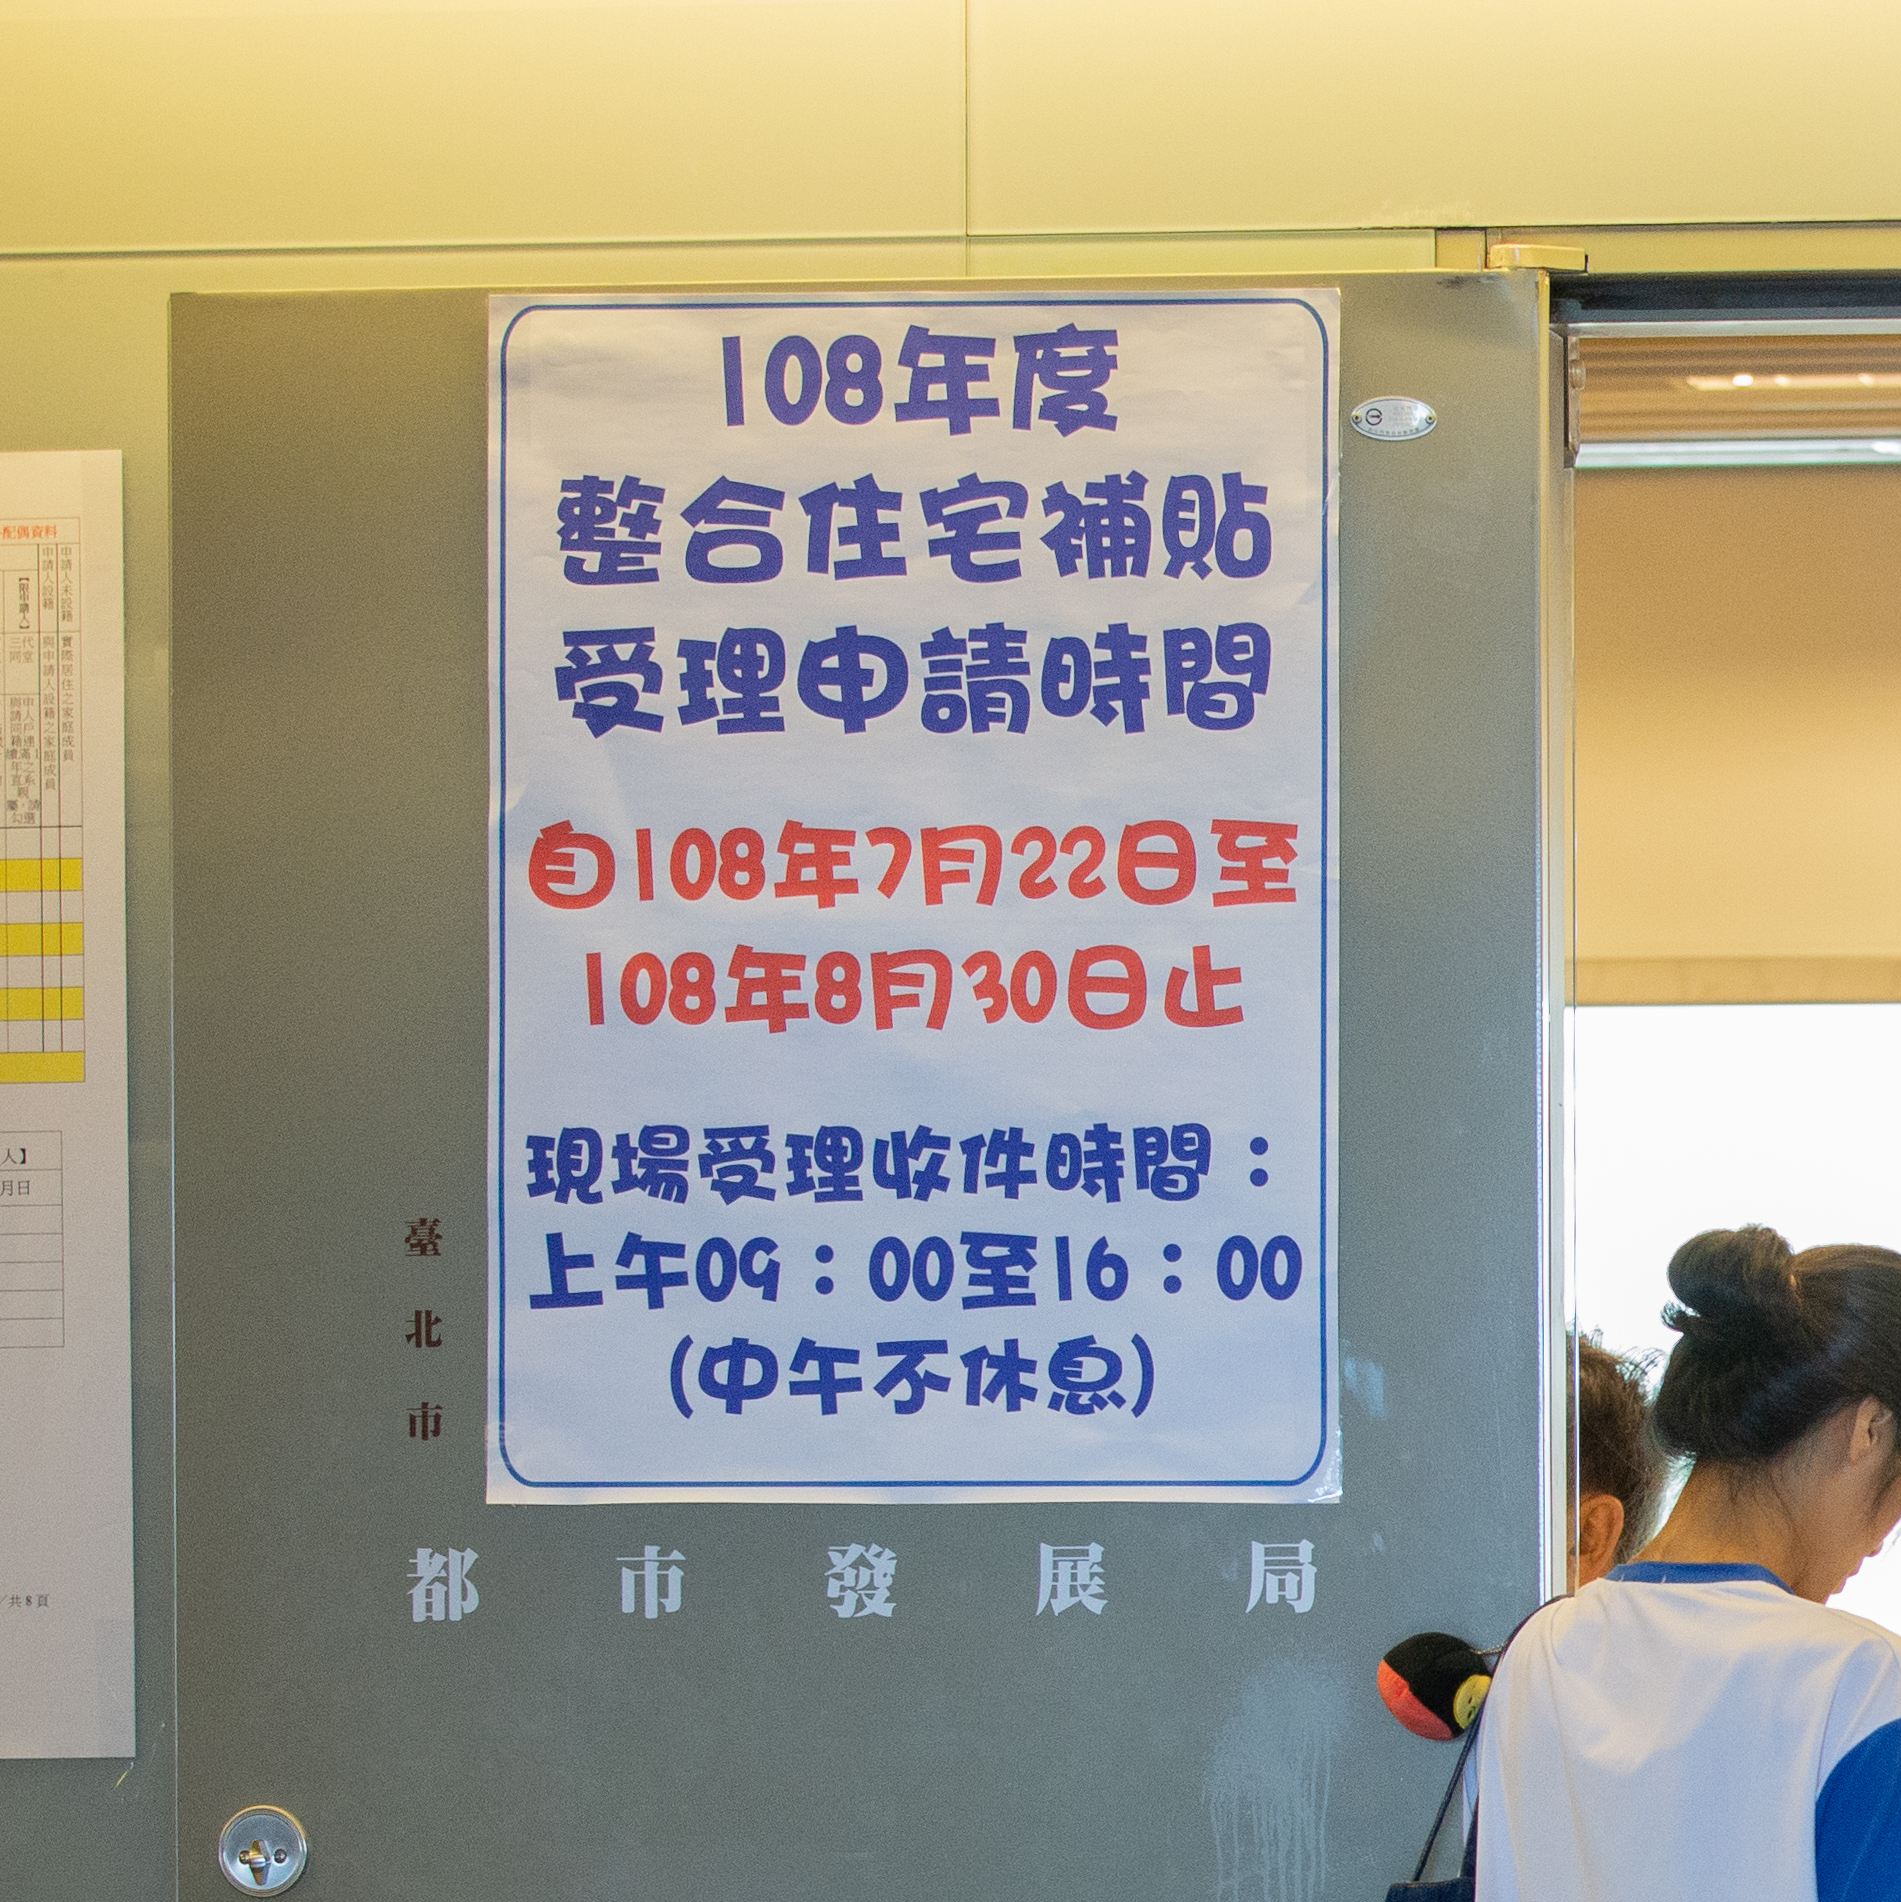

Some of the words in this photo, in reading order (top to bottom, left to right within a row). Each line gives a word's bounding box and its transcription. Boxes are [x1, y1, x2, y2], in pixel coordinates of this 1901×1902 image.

[722, 327, 1118, 433] 108年度
[557, 475, 1271, 584] 整合住宅補貼
[555, 624, 1271, 733] 受理申請時間
[528, 820, 1298, 906] 自108年7月22日至
[586, 946, 1243, 1029] 108年8月30日止
[0, 1180, 30, 1197] 月日
[526, 1125, 1268, 1202] 現場受理收件時間：
[529, 1233, 1302, 1308] 上午09：00至16：00
[404, 1218, 442, 1441] 臺北市
[670, 1337, 1154, 1414] (中午不休息)
[405, 1538, 1319, 1624] 都市發展局
